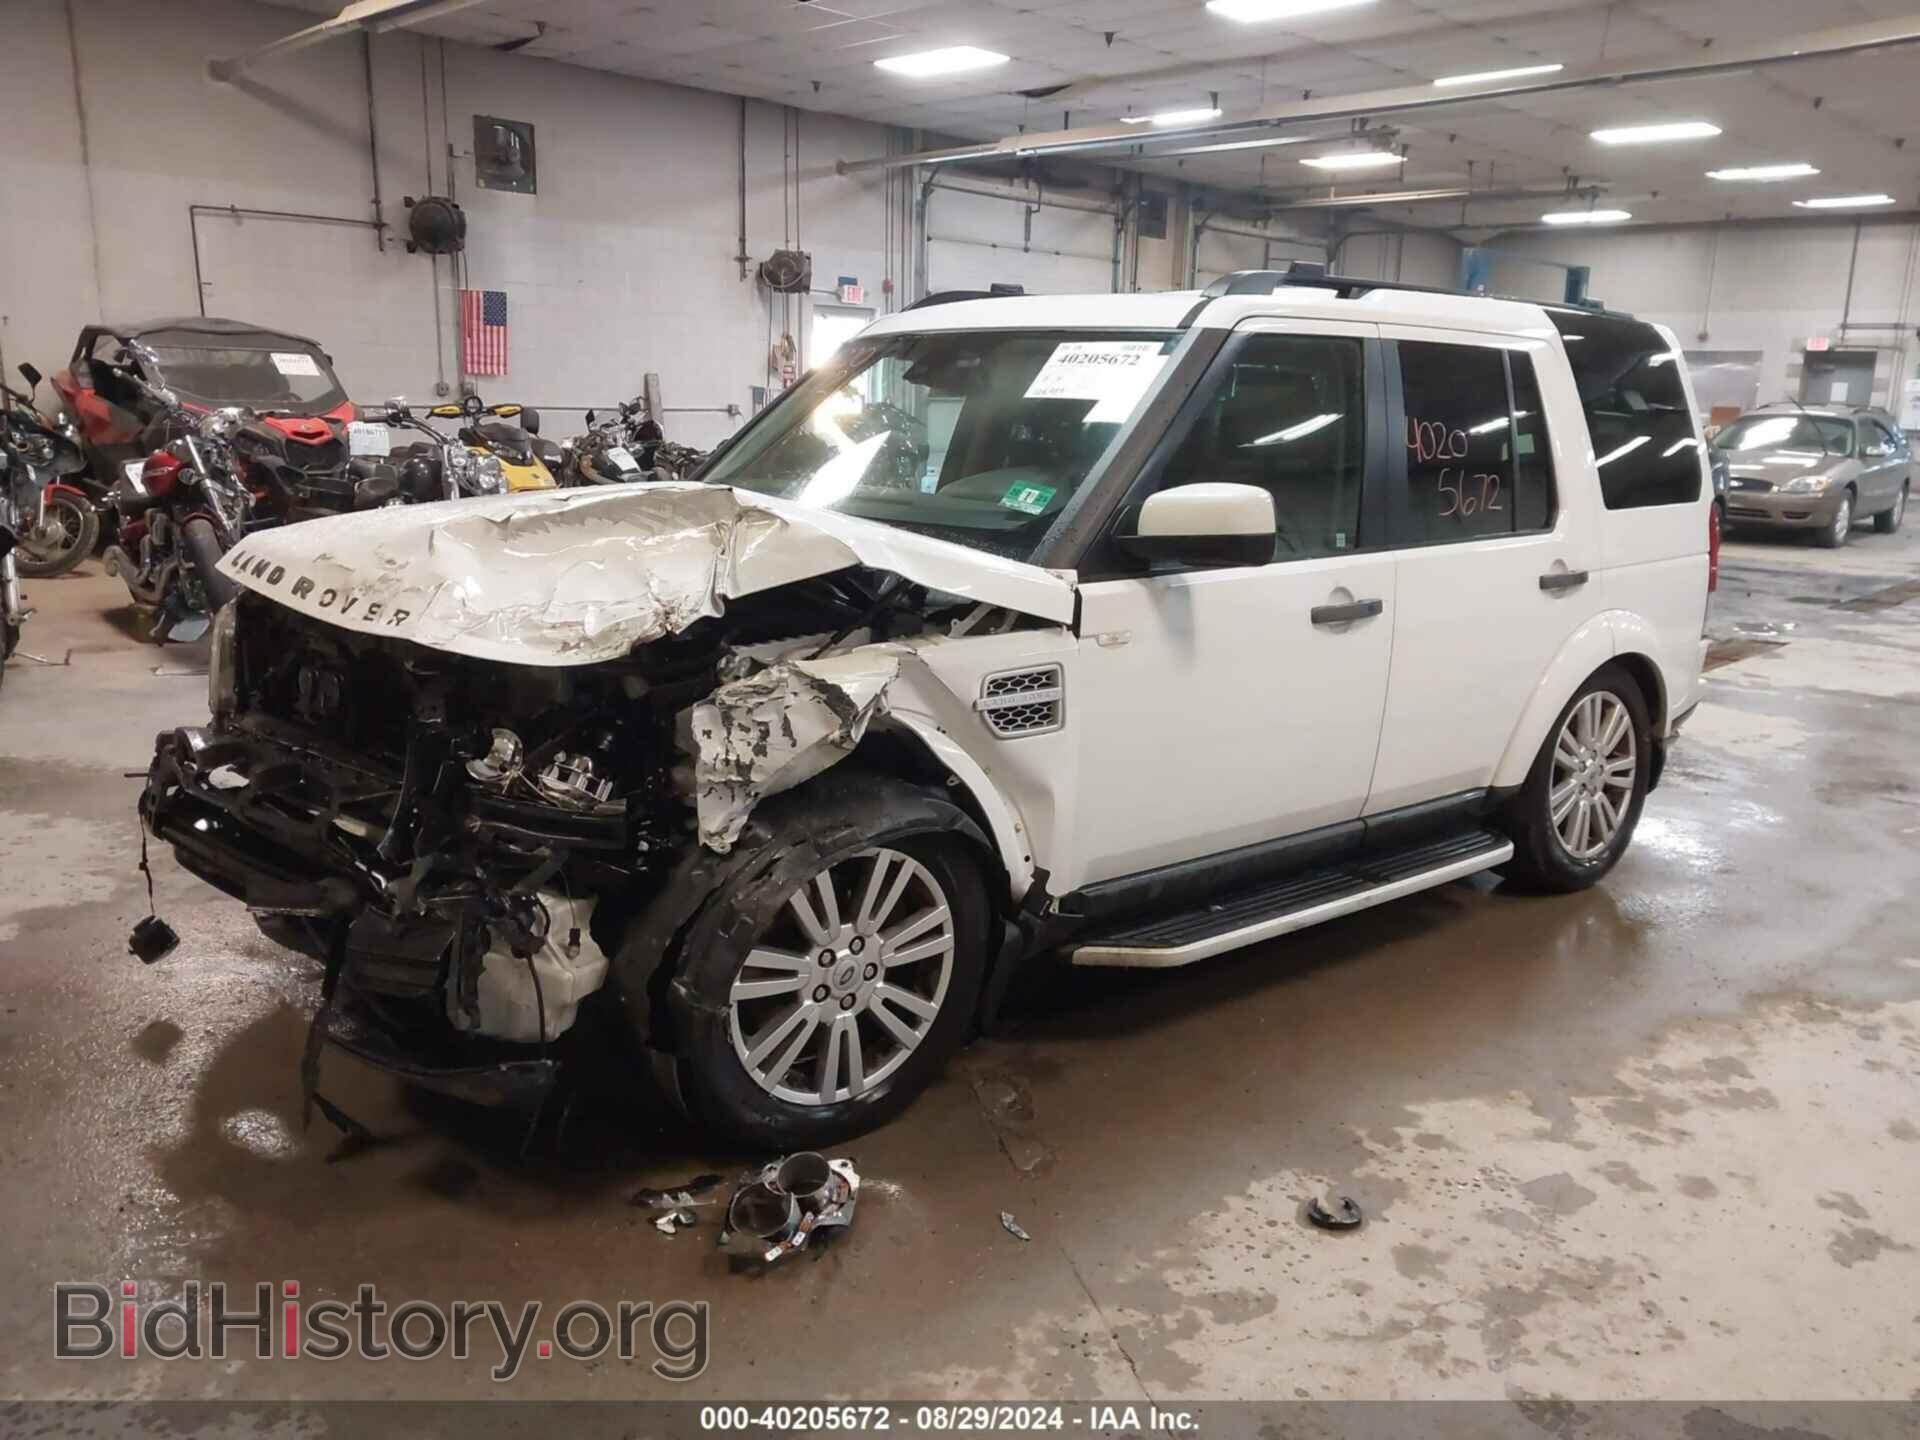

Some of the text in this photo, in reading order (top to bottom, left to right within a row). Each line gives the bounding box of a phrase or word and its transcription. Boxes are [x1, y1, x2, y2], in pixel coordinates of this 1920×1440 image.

[1057, 352, 1141, 367] 40205672
[1404, 417, 1468, 463] 4020
[1438, 467, 1503, 516] 5672
[231, 550, 410, 626] LAND ROVER
